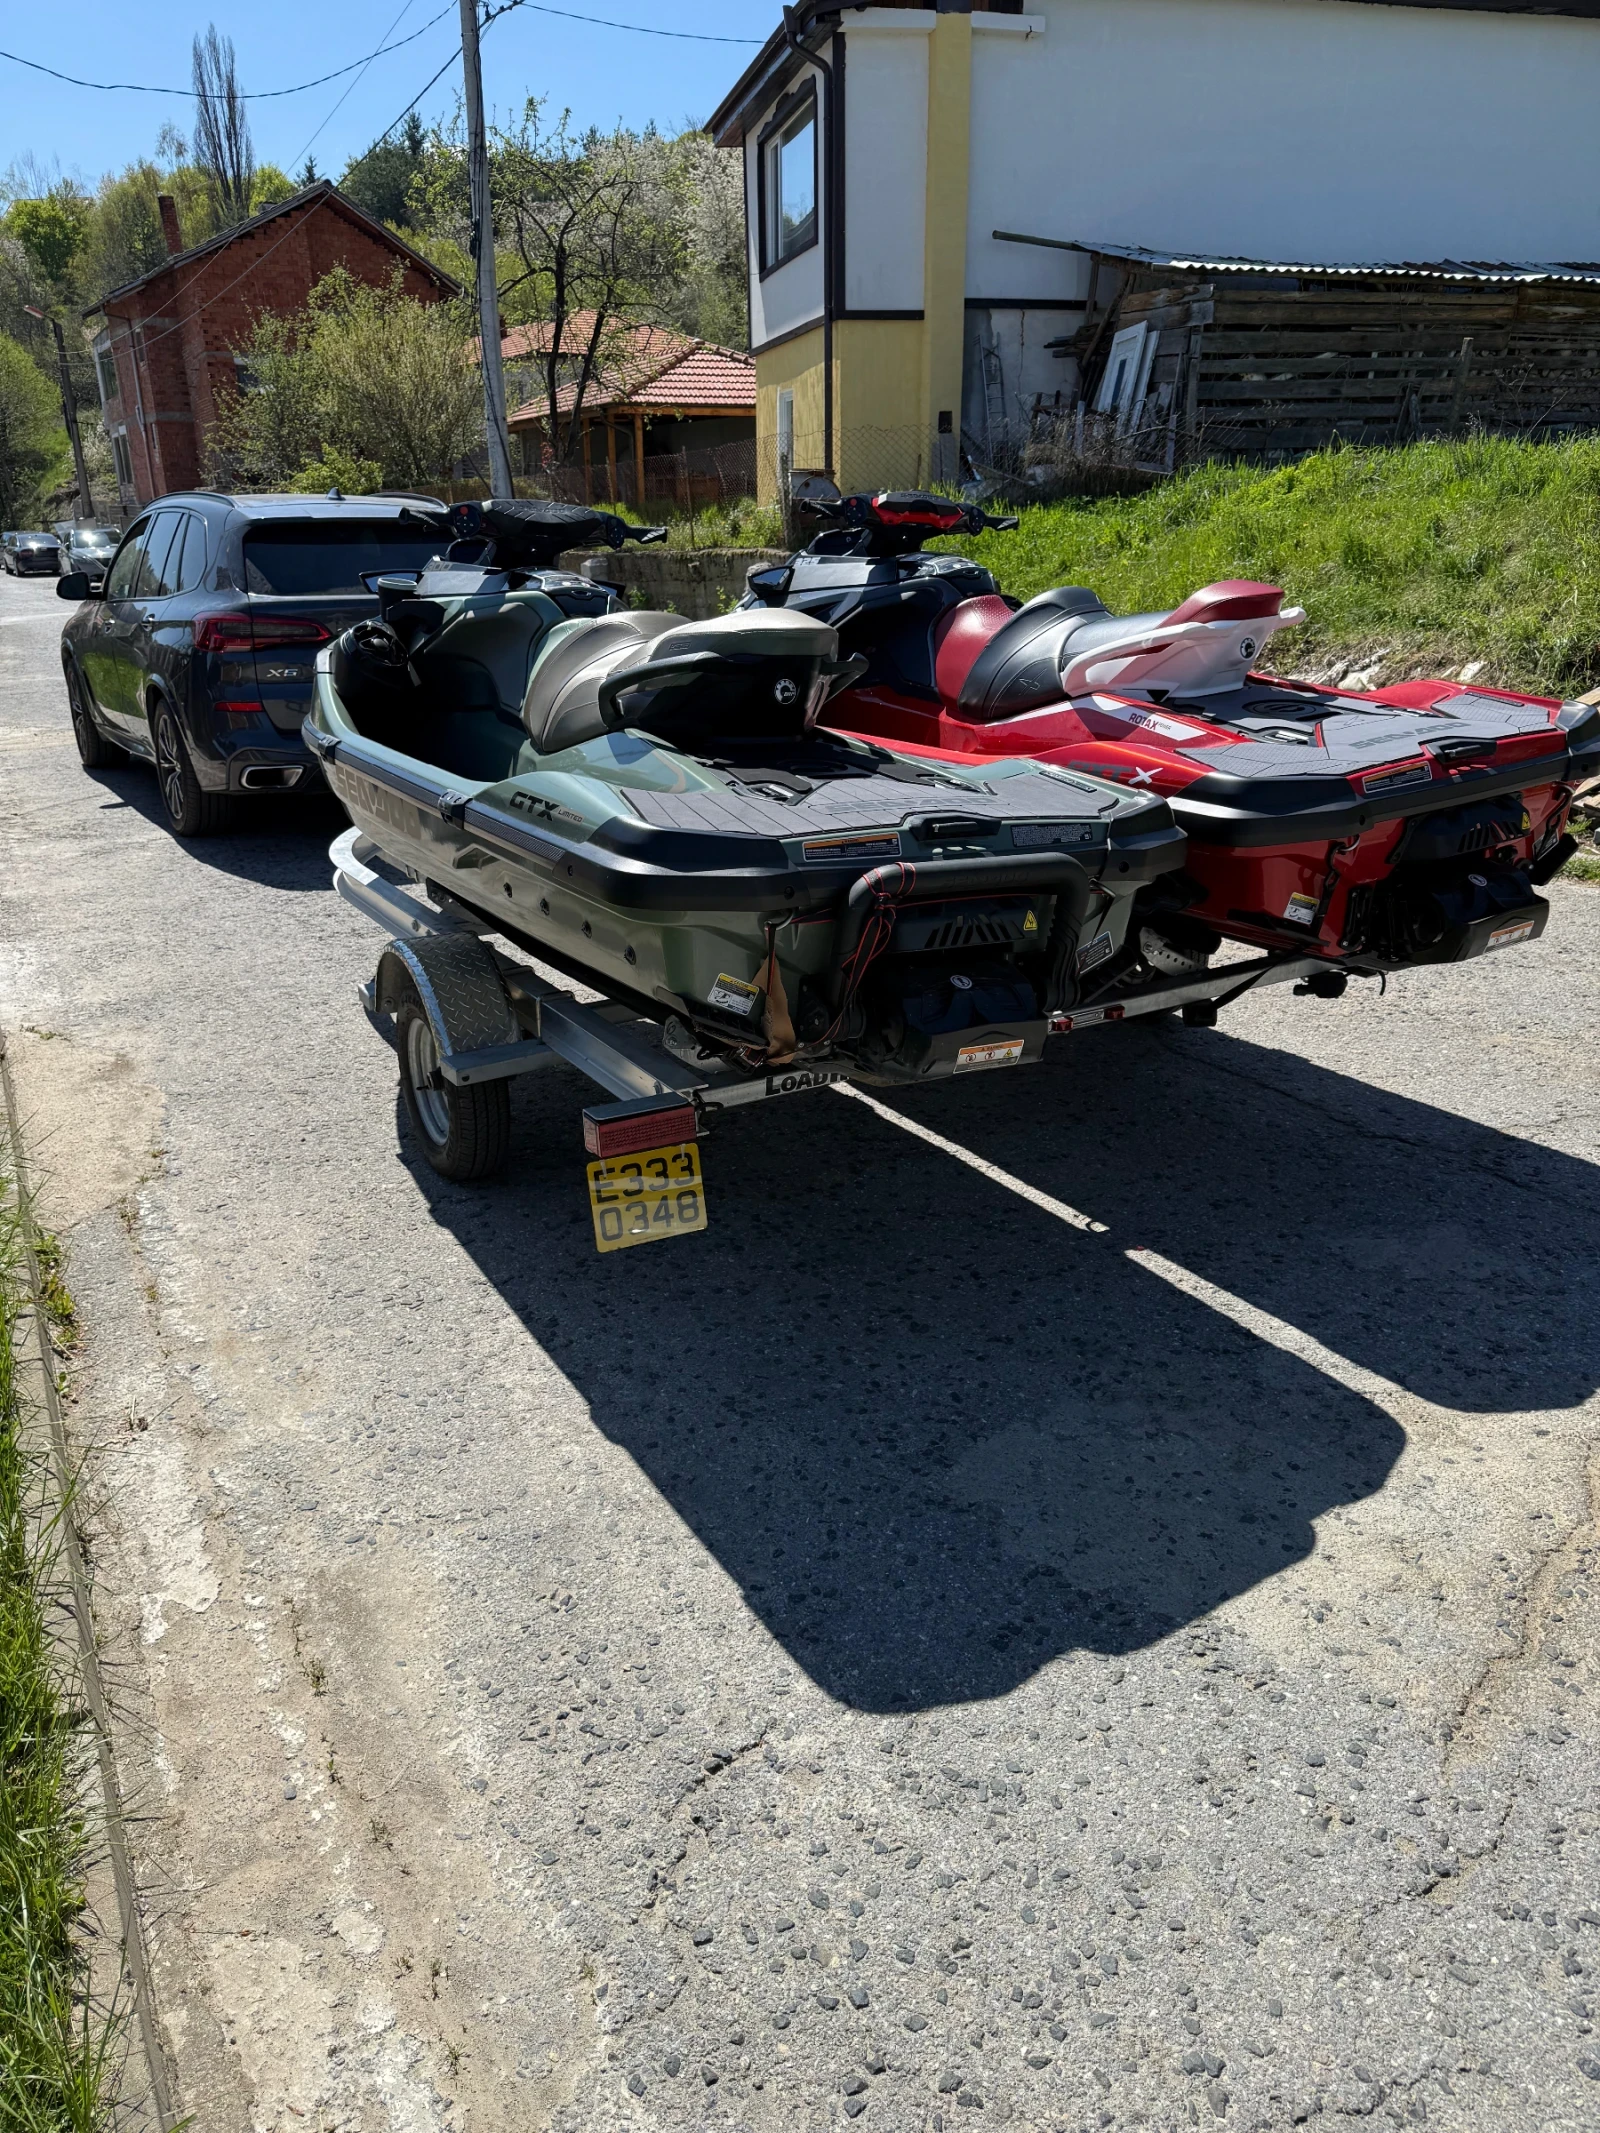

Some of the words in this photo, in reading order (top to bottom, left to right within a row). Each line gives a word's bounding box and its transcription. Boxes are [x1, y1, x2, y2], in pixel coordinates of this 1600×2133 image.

[1129, 713, 1159, 731] ROTAX
[510, 791, 560, 821] GTX
[558, 809, 583, 823] LIMITED
[594, 1153, 695, 1204] E333
